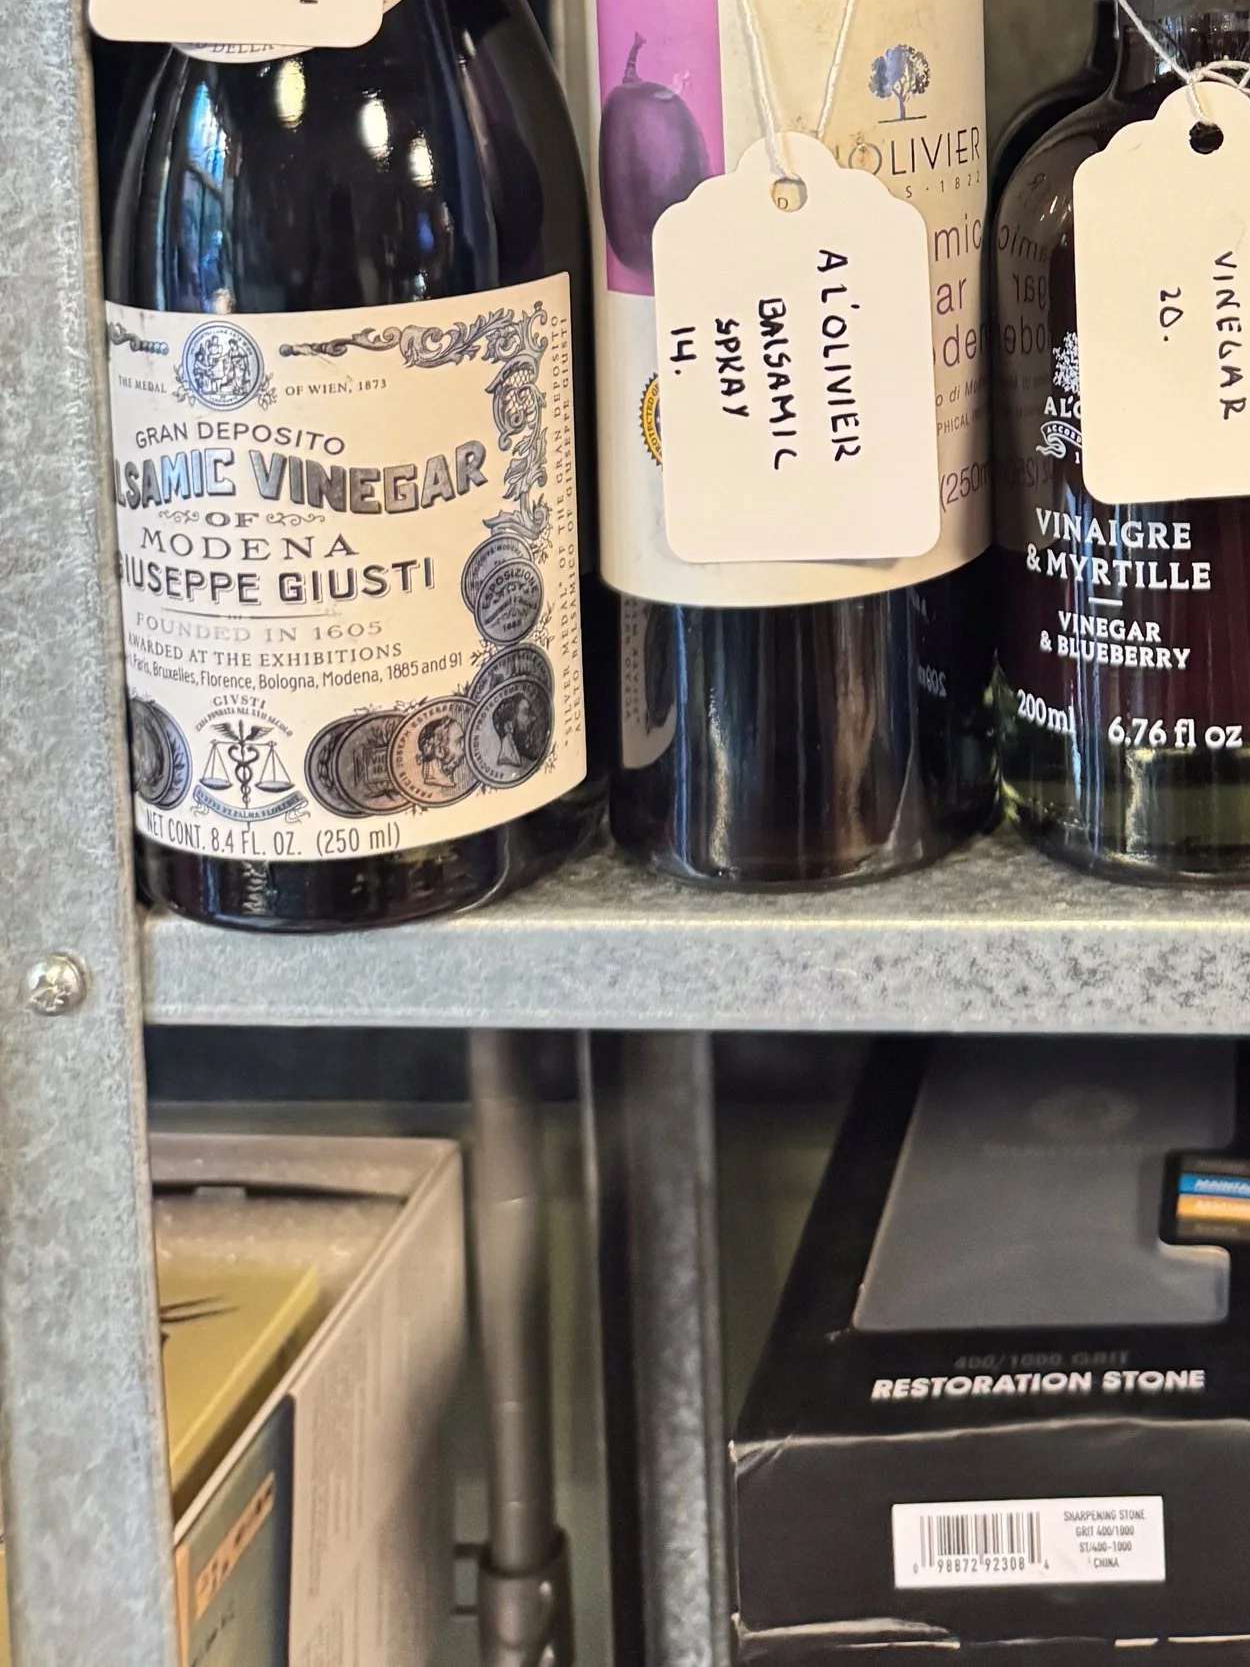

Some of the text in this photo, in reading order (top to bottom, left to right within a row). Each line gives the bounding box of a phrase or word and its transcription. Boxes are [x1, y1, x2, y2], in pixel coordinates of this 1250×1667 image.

[1158, 286, 1184, 342] 20.
[560, 318, 570, 388] GIUSTI
[1212, 251, 1247, 420] VINEGAR
[118, 375, 168, 393] THE MEDAL
[550, 316, 561, 418] DEPOSITO
[715, 318, 749, 418] SPRAY
[758, 297, 798, 470] BALSAMIC
[285, 379, 387, 397] OF WIEN, 1873
[135, 422, 345, 456] GRAN DEPOSITO
[553, 430, 564, 484] GRAN
[563, 399, 573, 497] GIUSEPPE
[249, 440, 488, 514] VINEGAR
[205, 512, 259, 528] OF
[557, 495, 566, 535] THE
[1036, 507, 1192, 550] VINAIGRE
[141, 527, 360, 561] MODENA
[278, 557, 435, 605] GIUSTI
[1026, 544, 1211, 590] & MYRTILLE
[567, 543, 578, 659] BALSAMICO
[136, 612, 383, 643] FOUNDED IN 1605
[1058, 611, 1161, 643] VINEGAR
[128, 632, 403, 667] AWARDED AT THE EXHIBITIONS
[1040, 631, 1191, 670] & BLUEBERRY
[153, 661, 199, 686] Bruxelles,
[201, 669, 256, 691] Florence,
[259, 673, 319, 692] Bologna,
[322, 668, 383, 688] Modena,
[388, 661, 419, 681] 1885
[421, 656, 447, 675] and
[449, 651, 463, 669] 91
[572, 669, 582, 733] ACETO
[1174, 718, 1197, 748] fl
[1204, 725, 1243, 749] oz
[145, 809, 401, 857] NET CONT. 8.4 FL. OZ. (250 ml)
[871, 1369, 1206, 1400] RESTORATION STONE
[1064, 1509, 1145, 1522] SHARPENING STONE
[1076, 1526, 1094, 1537] GRIT
[938, 1556, 978, 1573] 98872
[985, 1555, 1025, 1571] 92308
[1094, 1557, 1119, 1569] CHINA
